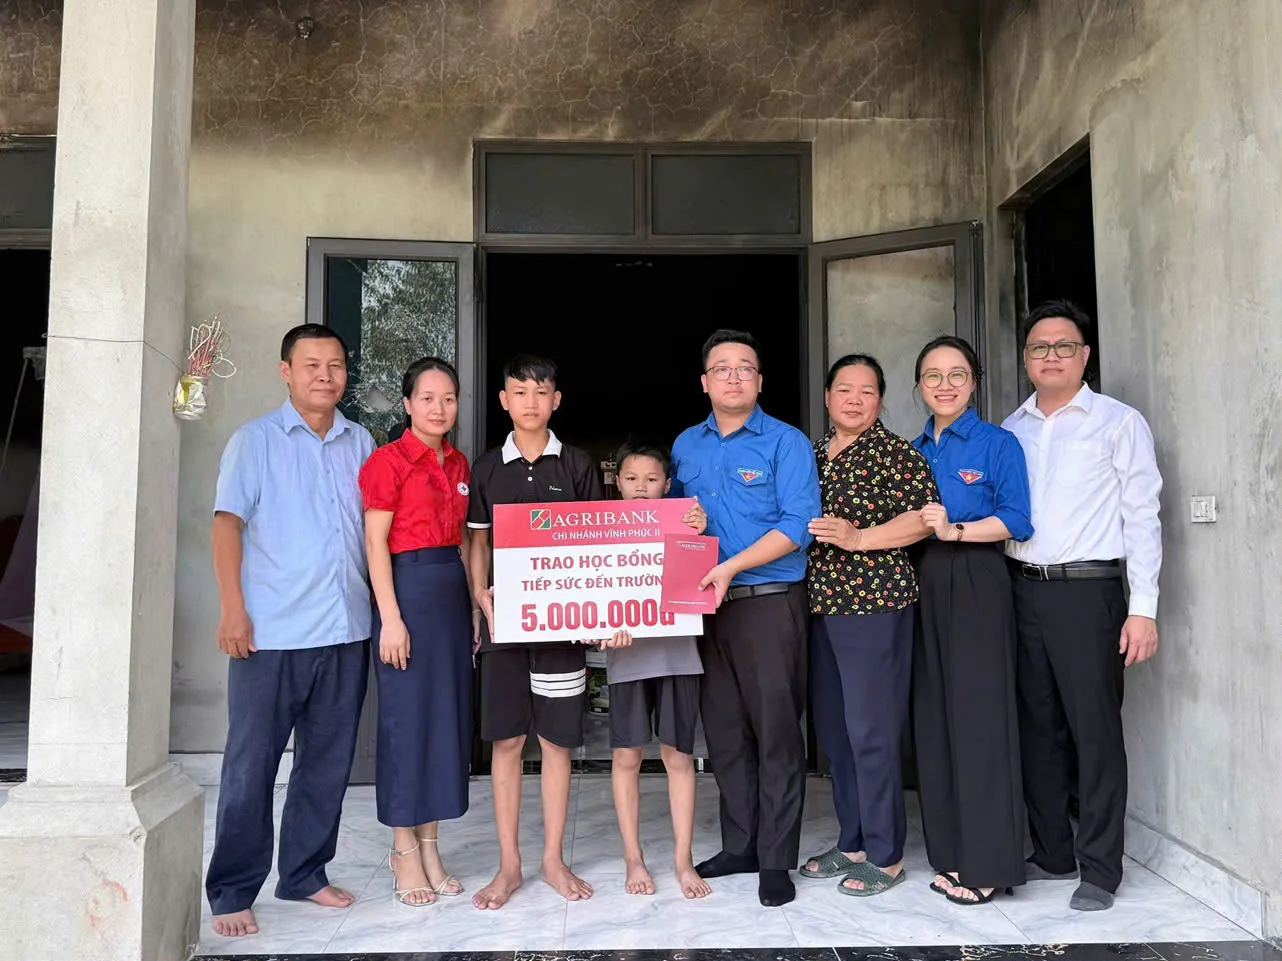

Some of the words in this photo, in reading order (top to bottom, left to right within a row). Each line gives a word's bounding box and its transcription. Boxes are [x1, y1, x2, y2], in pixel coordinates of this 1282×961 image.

[552, 510, 659, 527] AGRIBANK
[552, 531, 568, 541] CHI
[570, 528, 602, 540] NHÁNH
[604, 527, 626, 539] VĨNH
[628, 526, 652, 538] PHÚC
[530, 555, 574, 570] TRAO
[579, 554, 612, 572] HỌC
[617, 549, 663, 568] BỔNG
[522, 574, 551, 592] TIẾP
[555, 572, 582, 590] SỨC
[585, 571, 613, 589] ĐẾN
[616, 573, 663, 588] TRƯỜN
